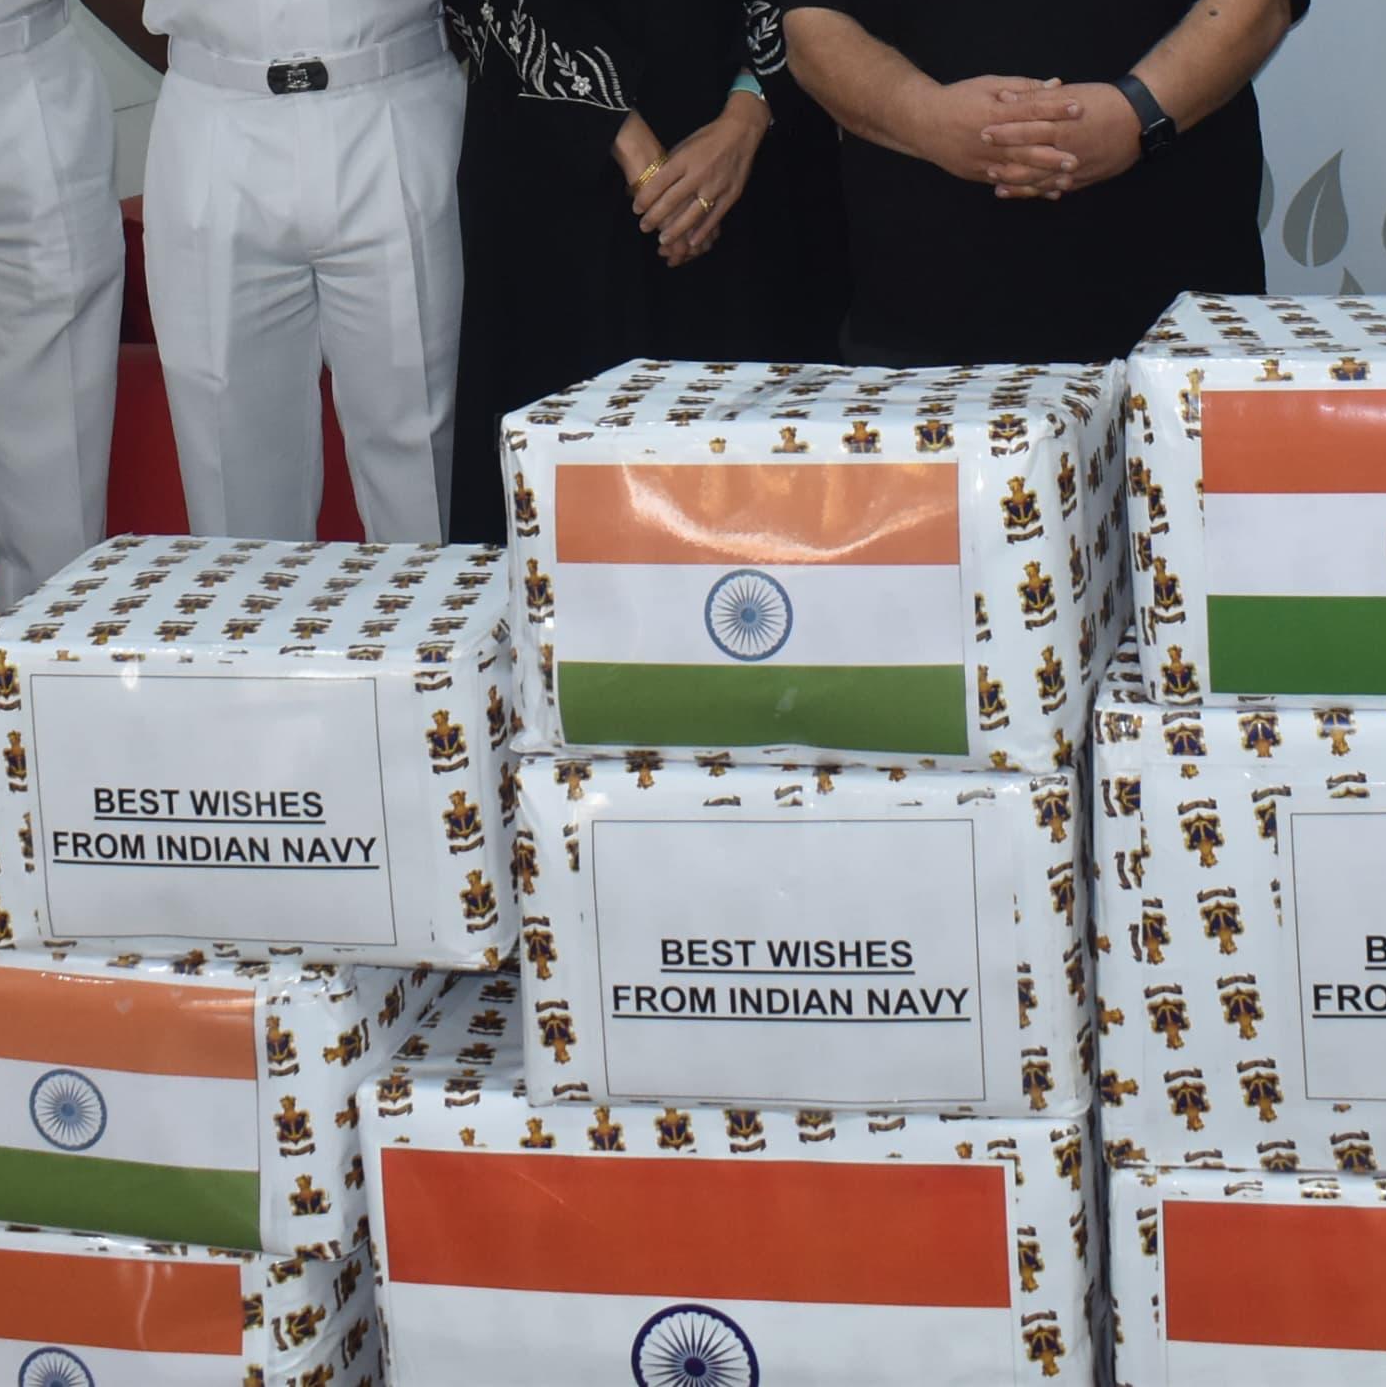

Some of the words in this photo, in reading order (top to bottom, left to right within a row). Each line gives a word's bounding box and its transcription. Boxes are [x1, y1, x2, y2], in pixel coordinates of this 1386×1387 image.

[94, 787, 180, 815] BEST
[190, 790, 324, 818] WISHES
[53, 831, 145, 861] FROM
[156, 834, 270, 864] INDIAN
[283, 837, 377, 864] NAVY
[660, 938, 756, 967] BEST
[767, 939, 913, 968] WISHES
[613, 985, 715, 1013] FROM
[729, 987, 853, 1015] INDIAN
[867, 987, 970, 1015] NAVY
